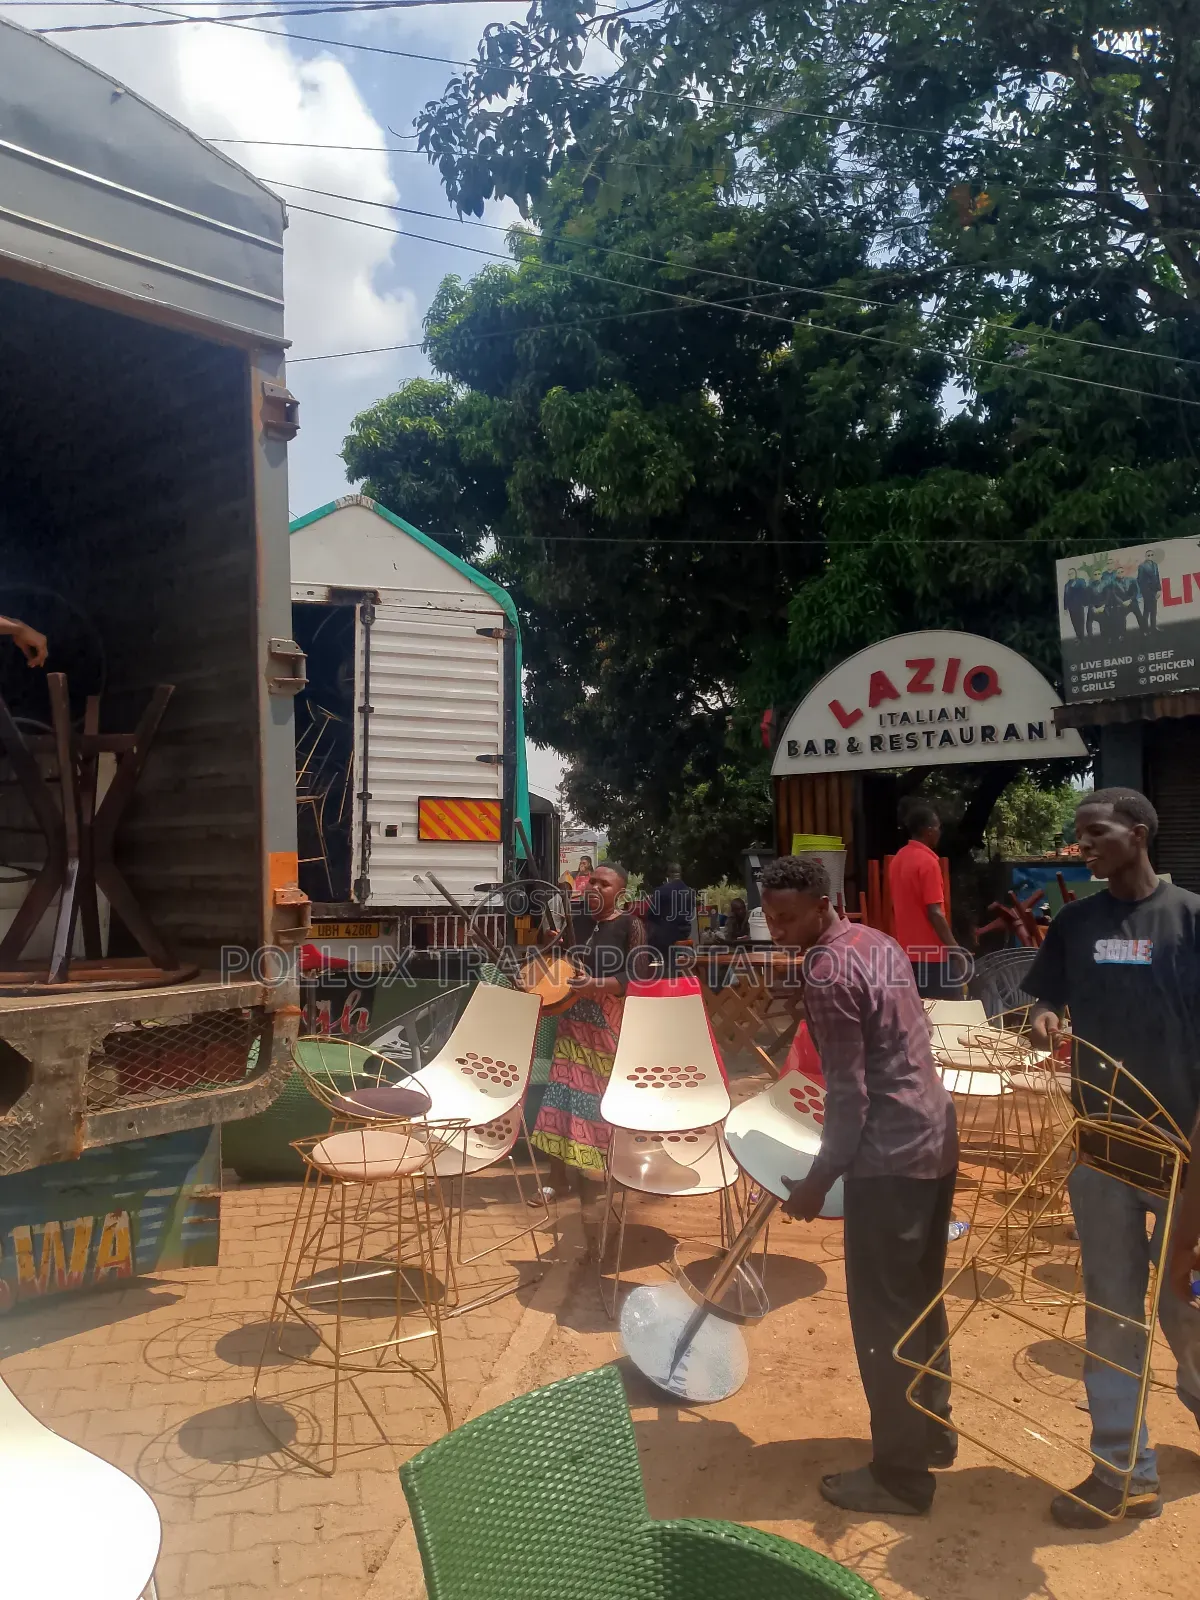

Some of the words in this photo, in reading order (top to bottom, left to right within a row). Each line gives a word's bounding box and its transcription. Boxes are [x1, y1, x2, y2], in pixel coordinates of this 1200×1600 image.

[1148, 650, 1174, 661] BEEF
[1080, 660, 1102, 671] LIVE
[1103, 656, 1133, 668] BAND
[1148, 659, 1195, 672] CHICKEN
[1081, 669, 1118, 682] SPIRITS
[1149, 672, 1179, 684] PORK
[1082, 681, 1115, 693] GRILLS
[879, 705, 969, 728] ITALIAN
[787, 738, 838, 757] BAR
[847, 736, 862, 755] &
[318, 924, 339, 937] UBH
